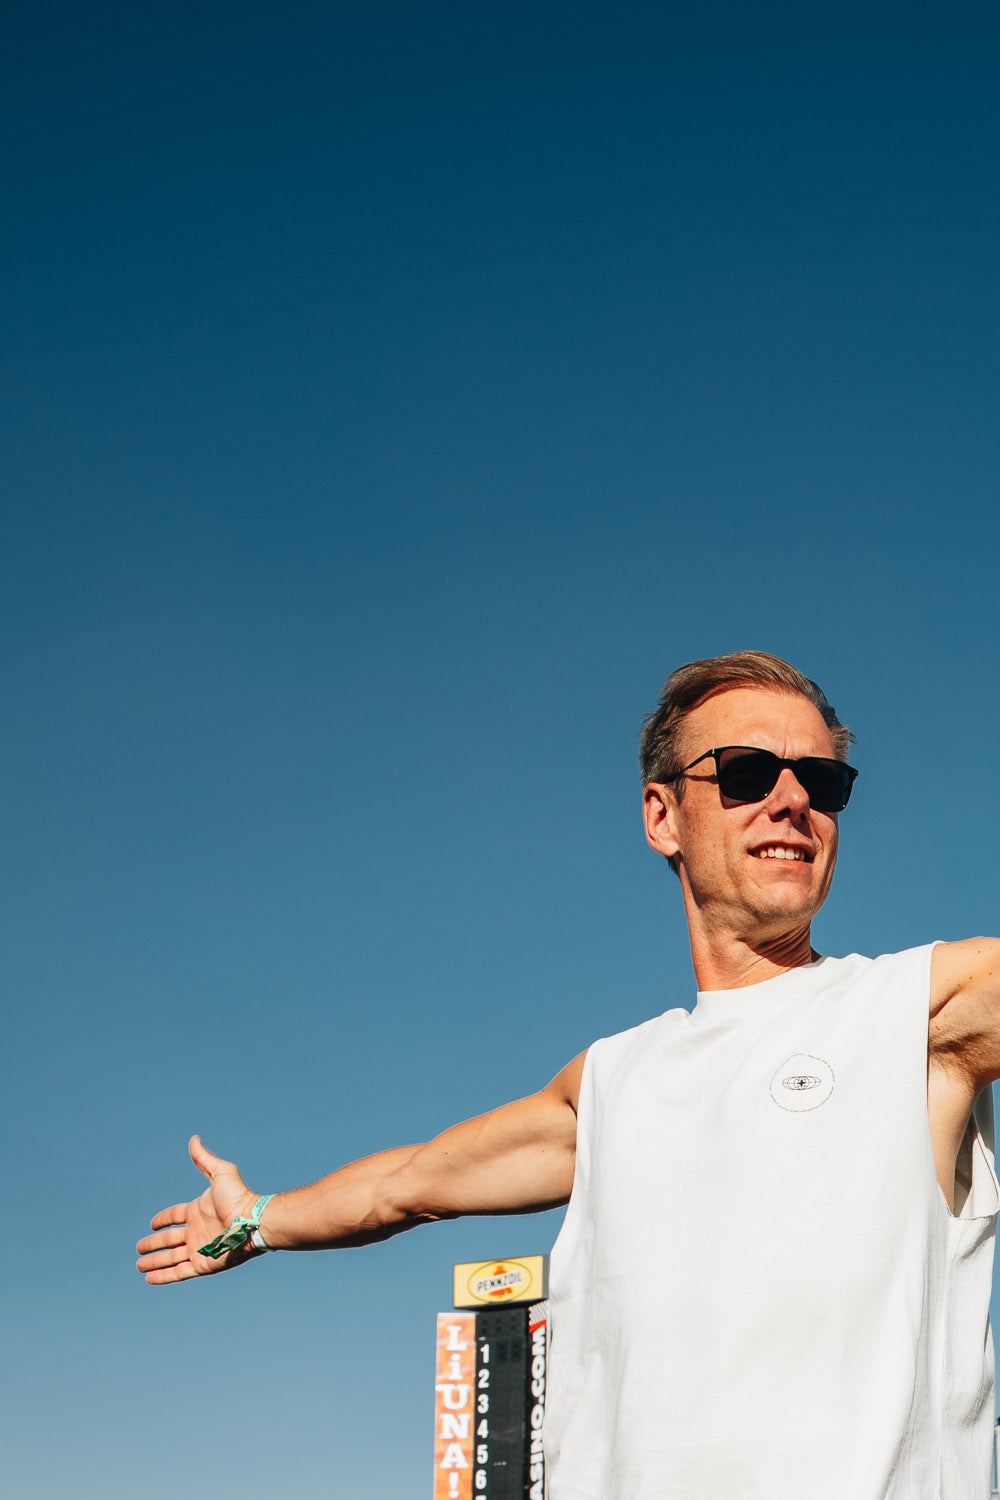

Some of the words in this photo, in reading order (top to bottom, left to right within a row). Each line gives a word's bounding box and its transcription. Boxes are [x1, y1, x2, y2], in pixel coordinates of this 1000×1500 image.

[476, 1271, 522, 1293] PENNZOIL
[479, 1344, 490, 1364] 1
[478, 1369, 490, 1389] 2
[477, 1394, 489, 1414] 3
[476, 1419, 489, 1439] 4
[476, 1444, 489, 1465] 5
[475, 1469, 487, 1490] 6
